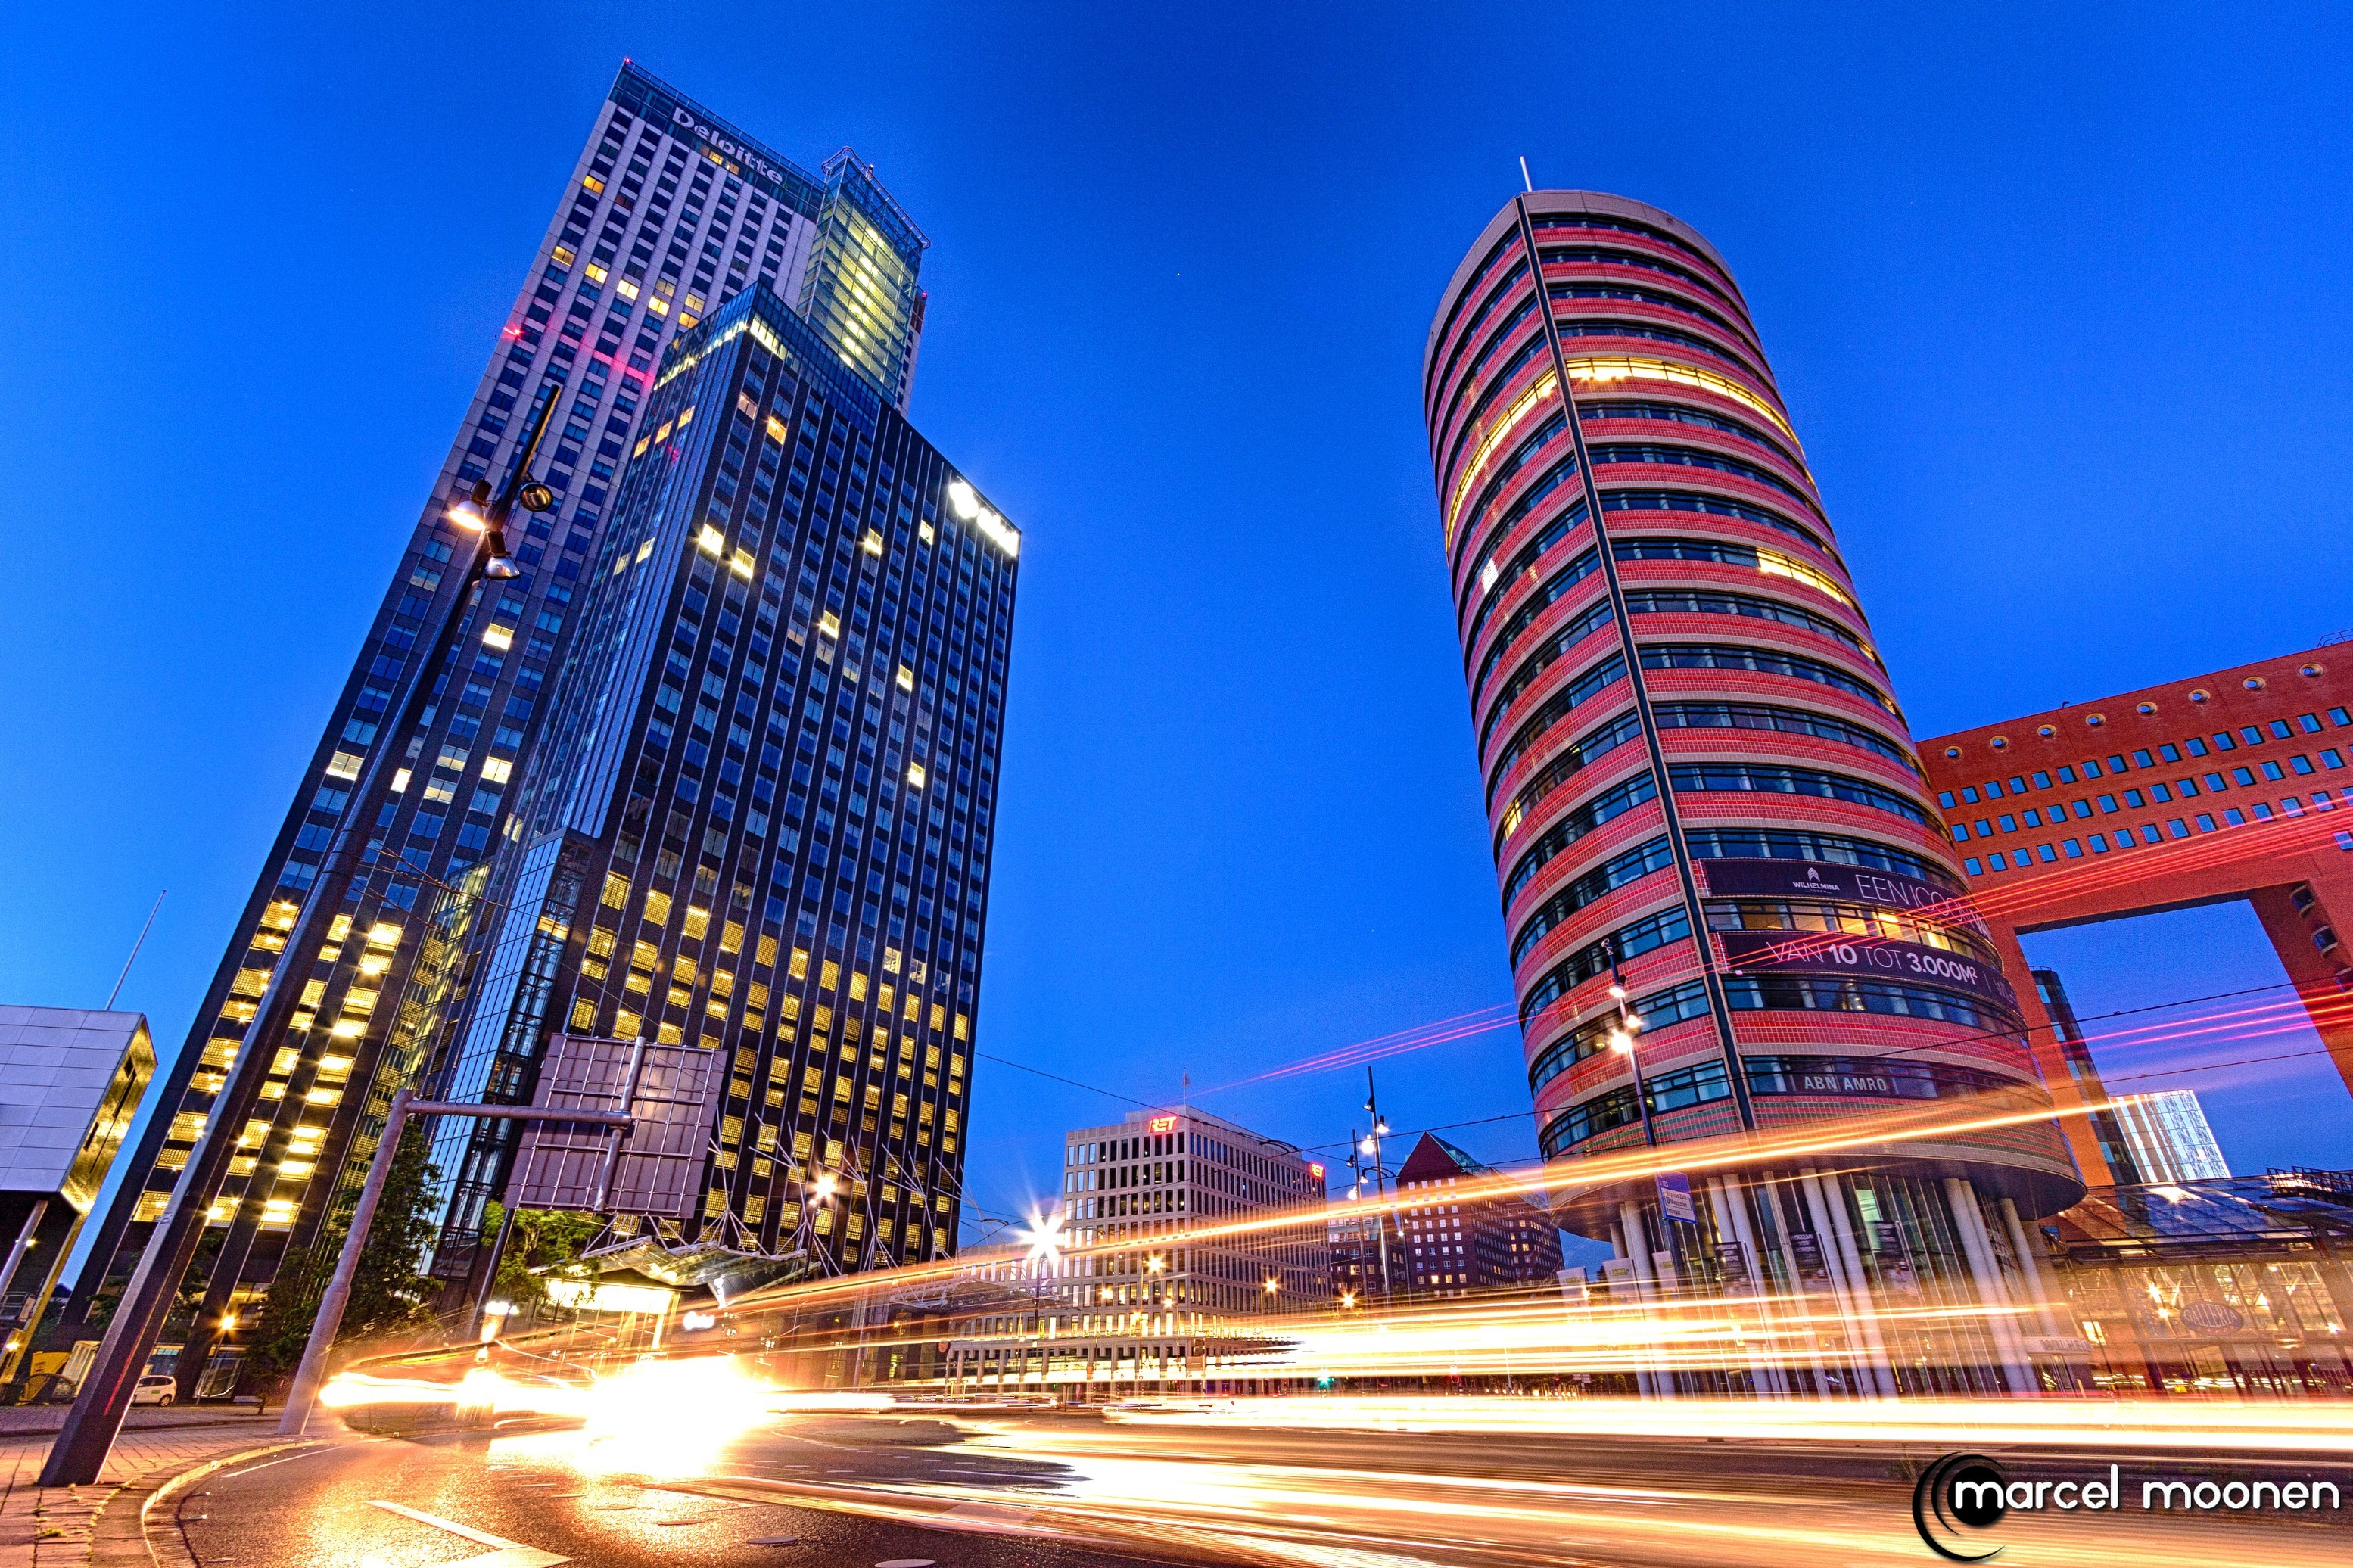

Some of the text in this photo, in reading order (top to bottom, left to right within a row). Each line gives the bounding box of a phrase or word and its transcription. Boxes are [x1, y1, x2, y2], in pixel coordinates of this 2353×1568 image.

[1792, 881, 1841, 891] WILHELMINA
[1855, 874, 1910, 906] EEN
[1766, 941, 1825, 963] VAN
[1828, 944, 1857, 965] 10
[1859, 946, 1902, 969] TOT
[1804, 1076, 1887, 1091] ABN AMRO
[1148, 1115, 1178, 1133] RET
[1311, 1163, 1324, 1178] RET
[2183, 1303, 2238, 1328] GALLERIA
